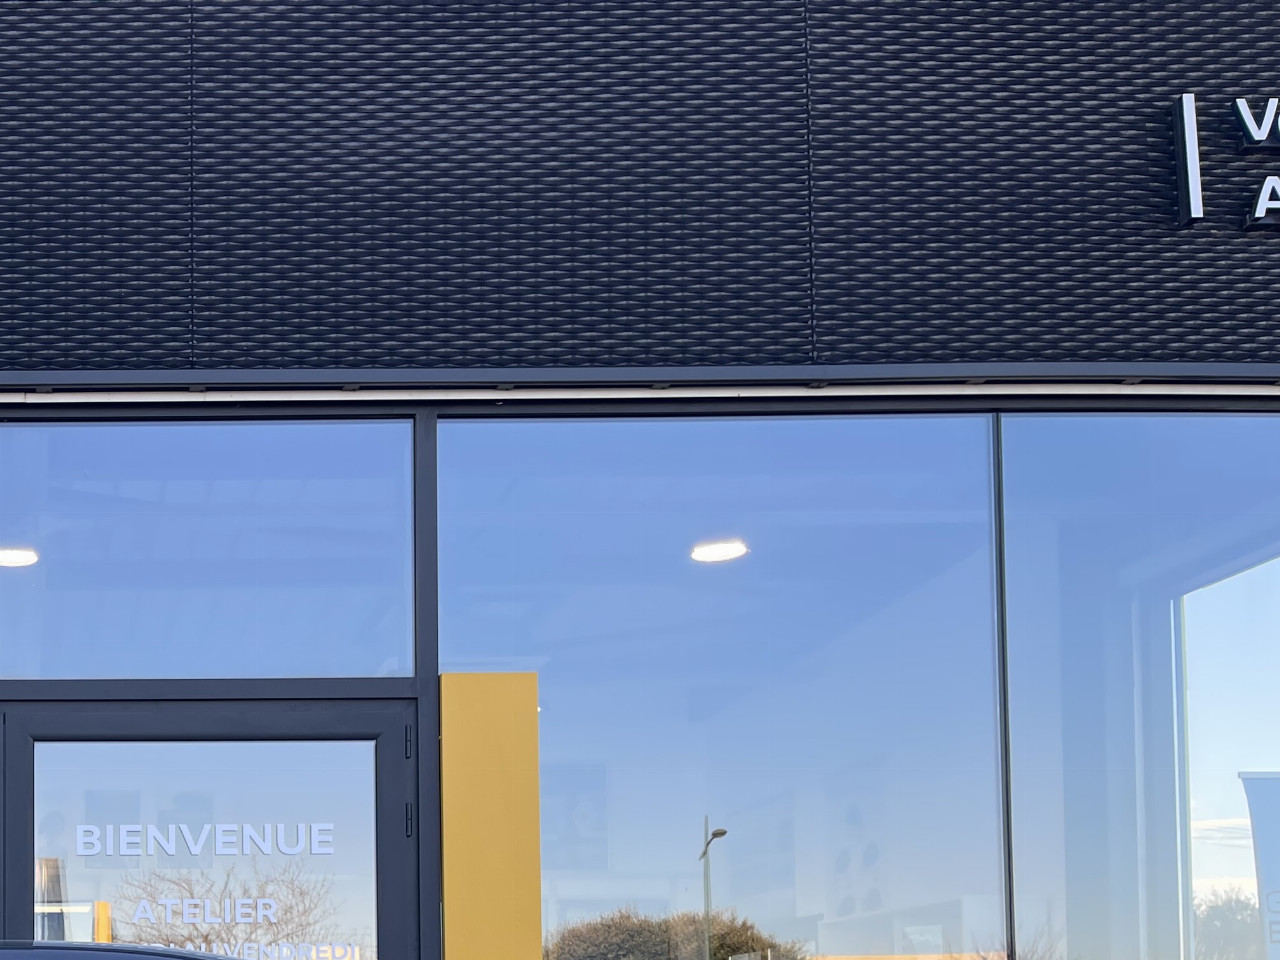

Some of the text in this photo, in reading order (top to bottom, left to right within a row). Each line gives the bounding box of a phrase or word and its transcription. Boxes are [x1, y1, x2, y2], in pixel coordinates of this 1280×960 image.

[1236, 98, 1280, 140] V
[75, 823, 335, 857] BIENVENUE
[132, 898, 279, 924] ATELIER
[222, 943, 359, 960] VENDREDI
